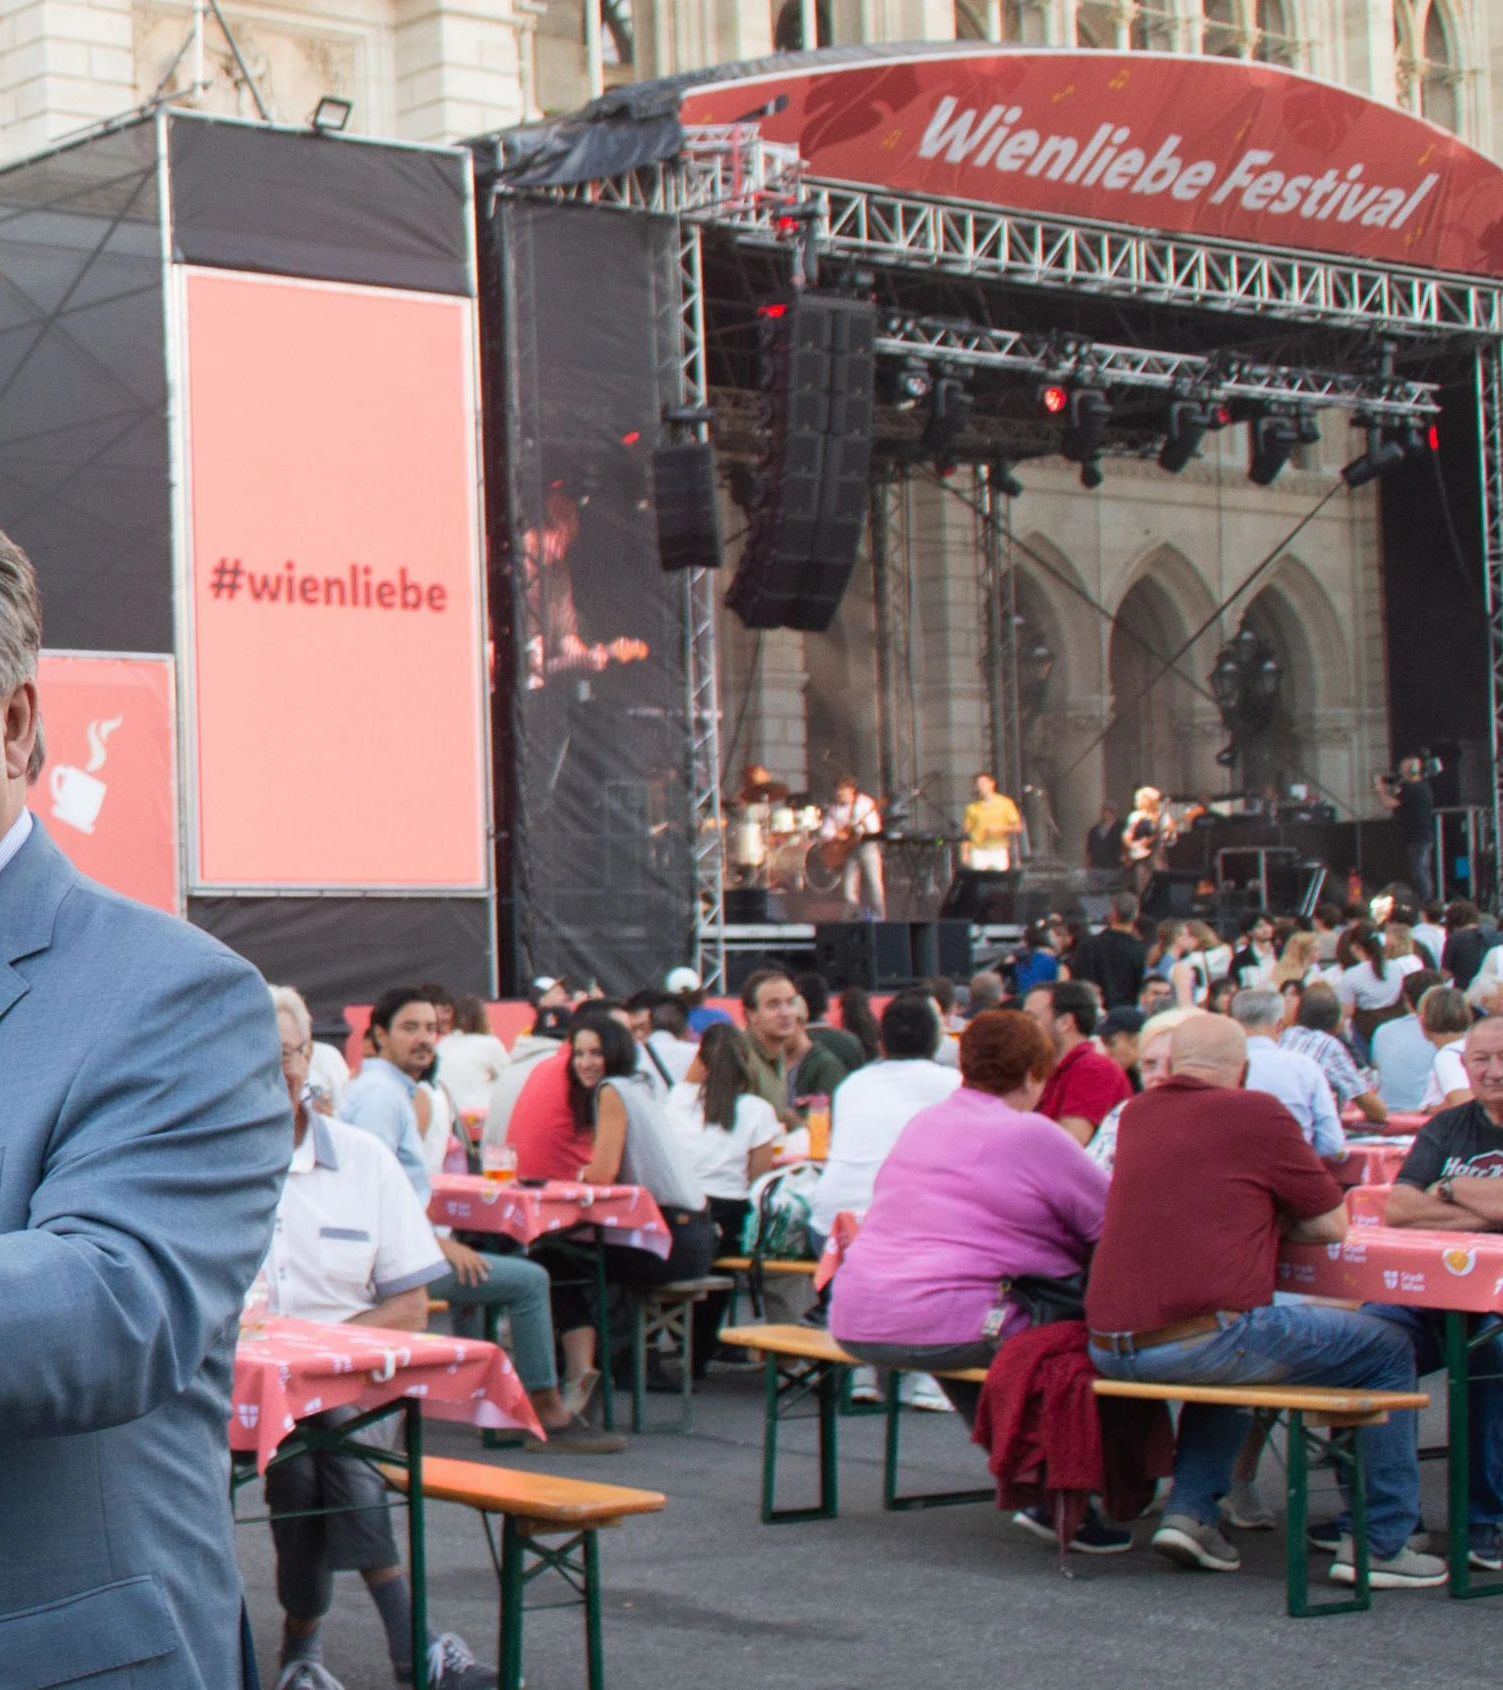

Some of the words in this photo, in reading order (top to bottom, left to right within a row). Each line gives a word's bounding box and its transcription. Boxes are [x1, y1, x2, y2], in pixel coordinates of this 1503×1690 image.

[917, 95, 1217, 202] Wienliebe
[1212, 148, 1441, 231] Festival
[210, 557, 449, 612] #wienliebe
